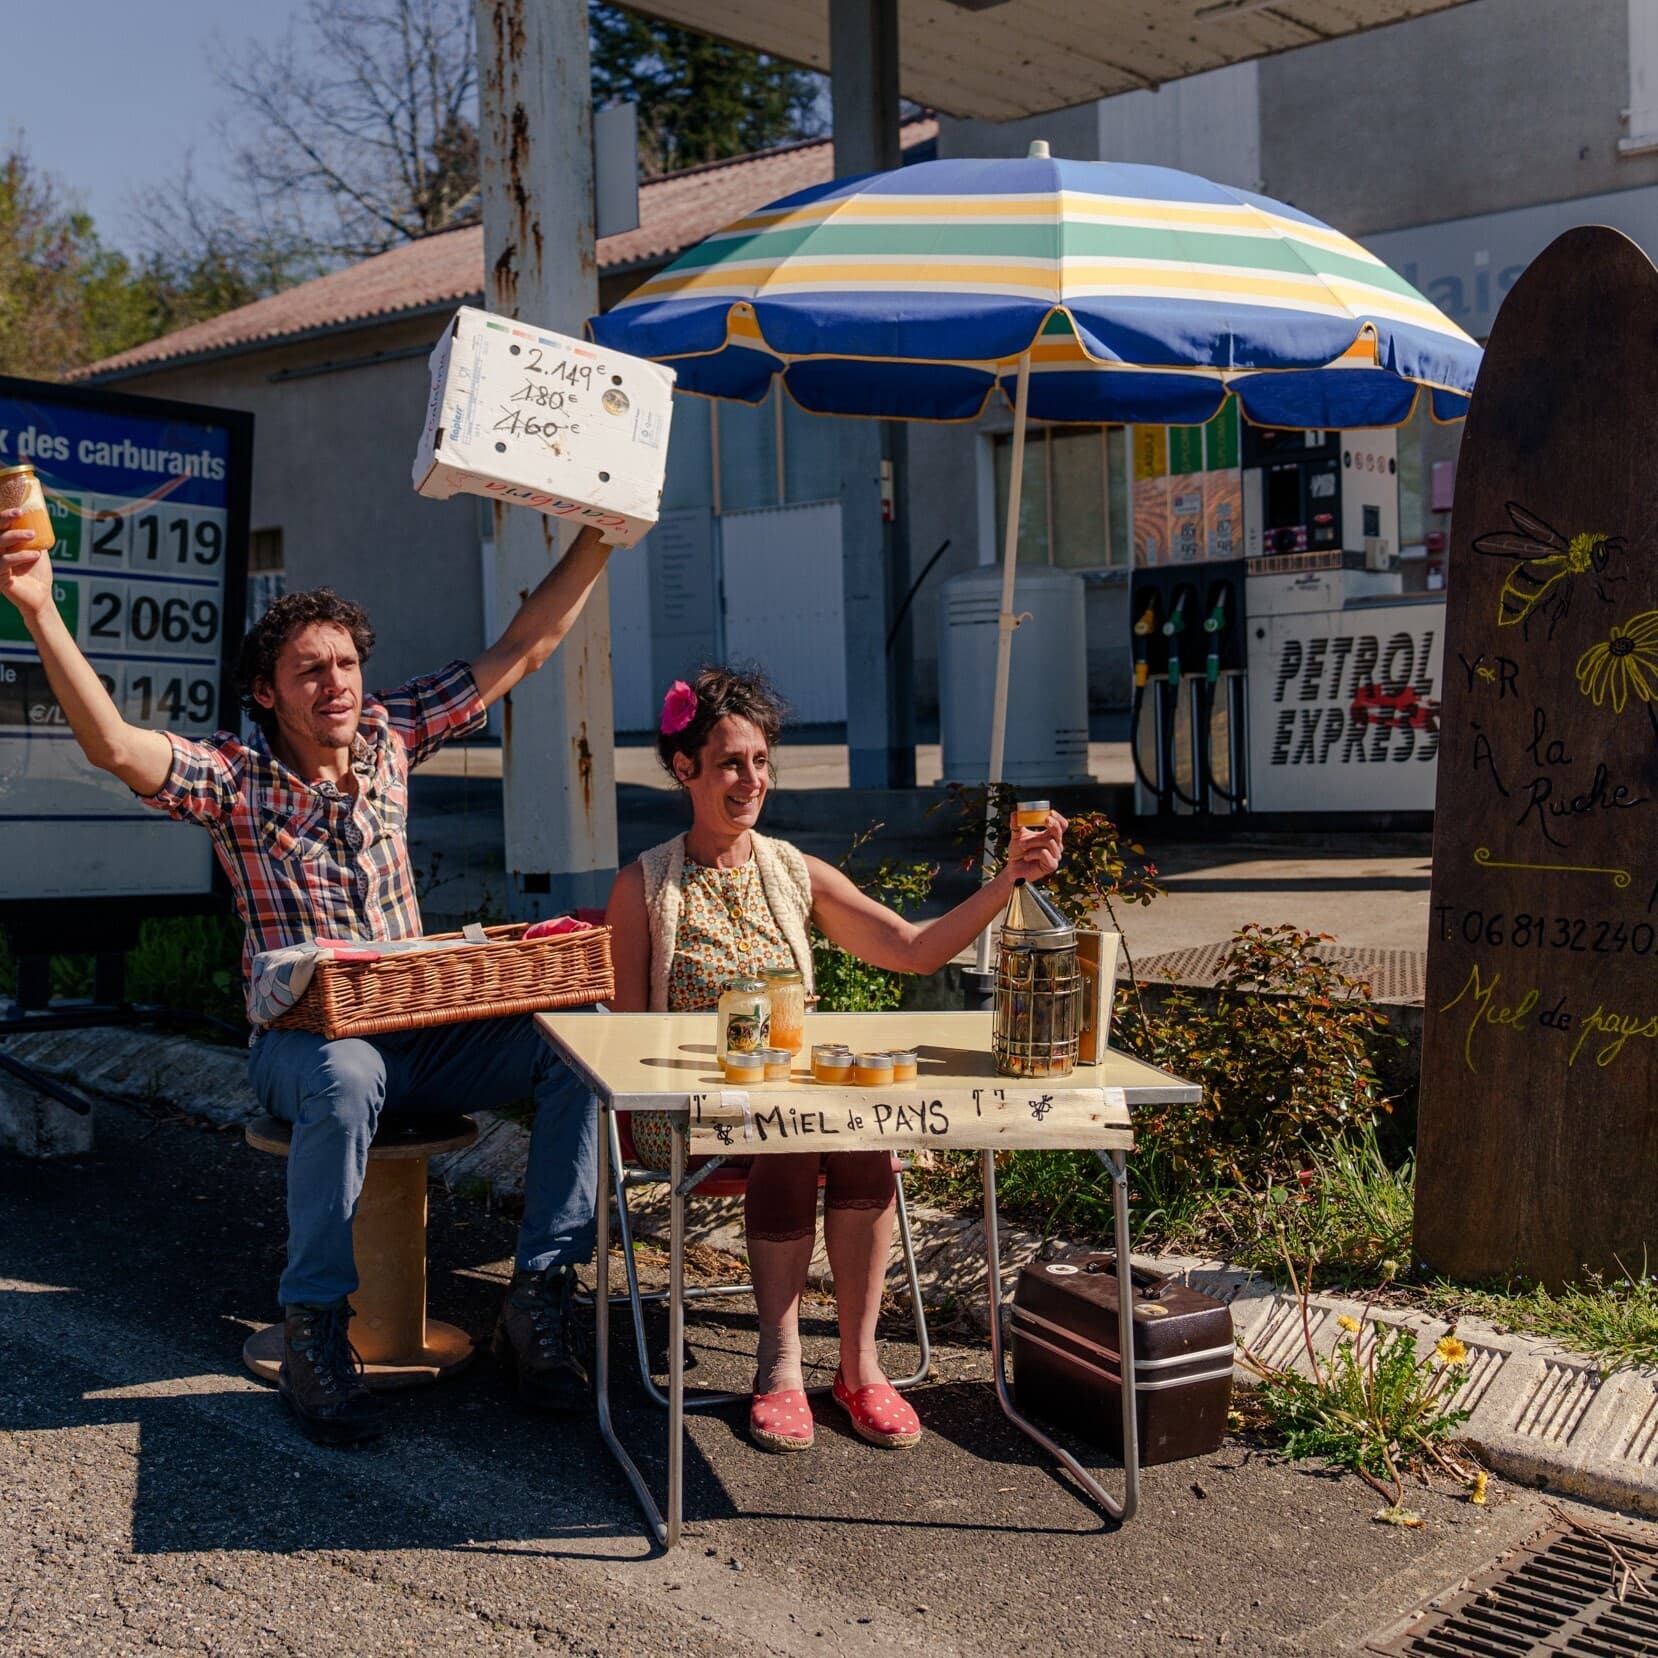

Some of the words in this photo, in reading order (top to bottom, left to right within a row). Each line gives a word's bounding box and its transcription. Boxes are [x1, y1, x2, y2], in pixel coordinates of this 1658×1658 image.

[18, 426, 70, 461] des
[78, 439, 225, 480] carburants
[483, 481, 625, 527] Calabria
[92, 509, 222, 565] 2119
[90, 592, 219, 644] 2069
[1272, 631, 1434, 702] PETROL
[1270, 700, 1441, 765] EXPRESS
[1470, 720, 1510, 797] À
[1526, 706, 1573, 767] la
[1517, 762, 1648, 848] Ruche
[1439, 964, 1540, 1074] Miel
[1540, 996, 1572, 1030] de
[1569, 1005, 1658, 1066] pays
[847, 1108, 864, 1131] de
[872, 1099, 949, 1135] PAYS
